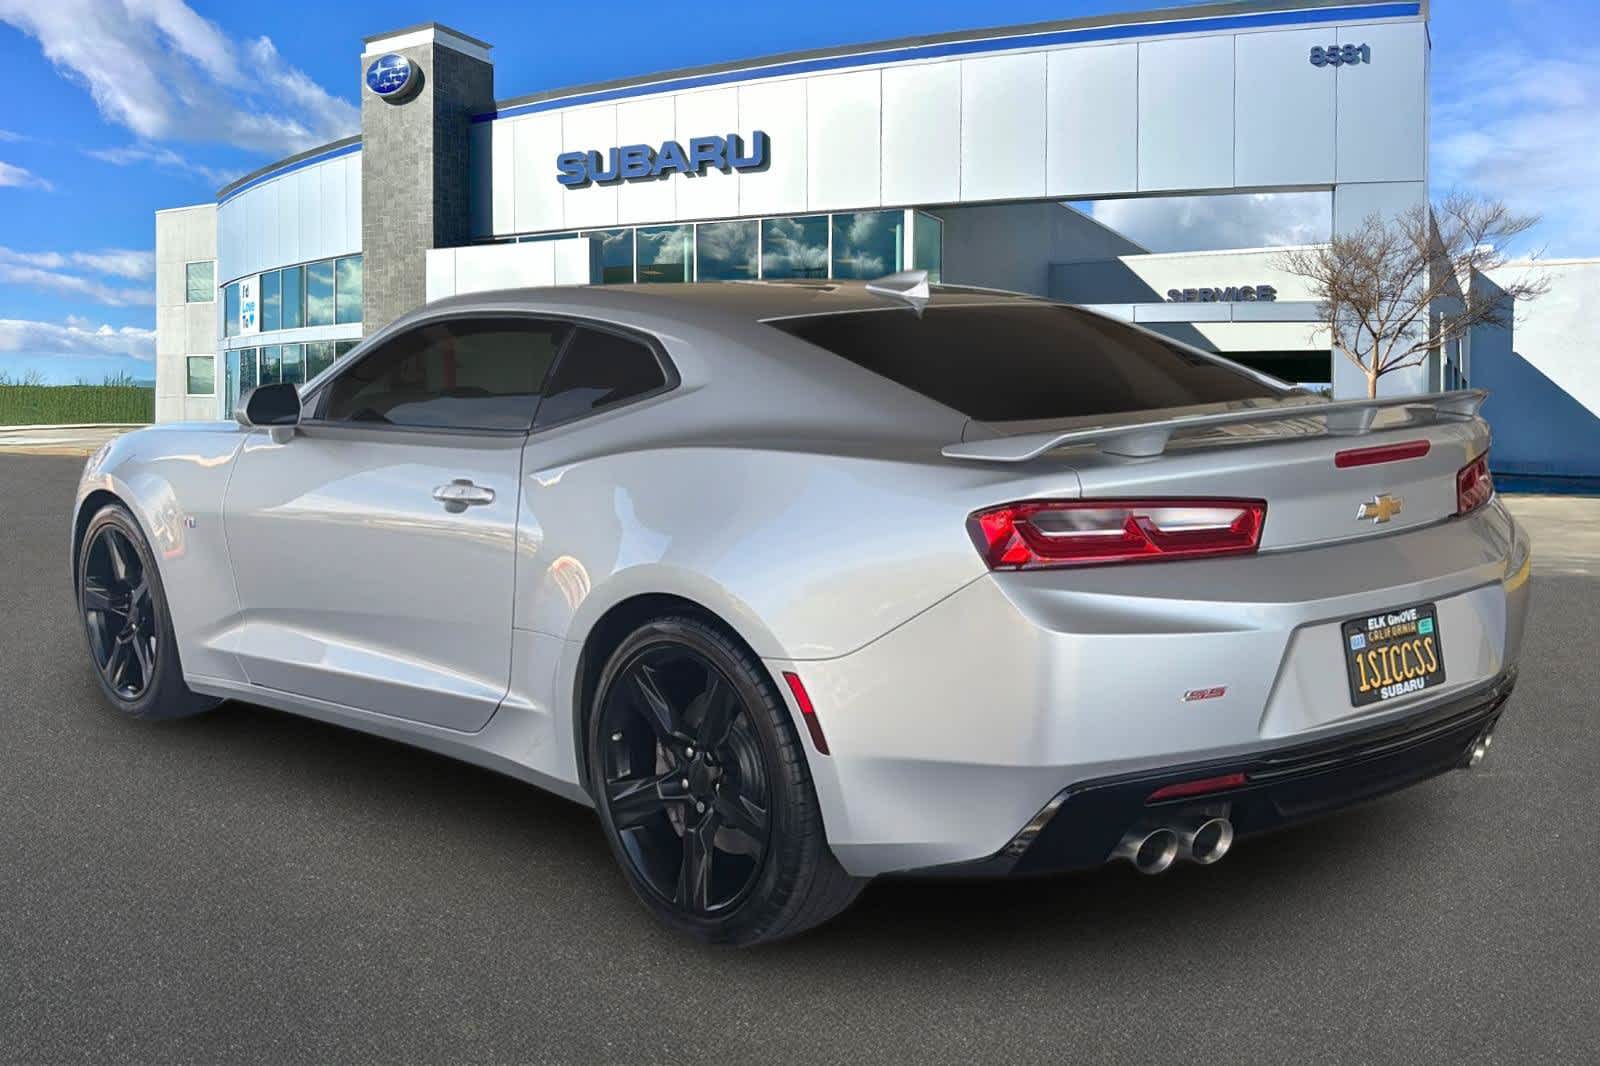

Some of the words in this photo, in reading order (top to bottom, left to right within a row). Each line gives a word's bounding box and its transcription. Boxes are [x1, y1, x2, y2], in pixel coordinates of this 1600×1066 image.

[556, 130, 770, 189] SUBARU
[1166, 285, 1277, 302] SERVICE
[1368, 615, 1386, 630] ELK
[1368, 620, 1416, 642] CALIFORNIA
[1356, 637, 1437, 692] 1SICCSS
[1381, 677, 1425, 699] SUBARU
